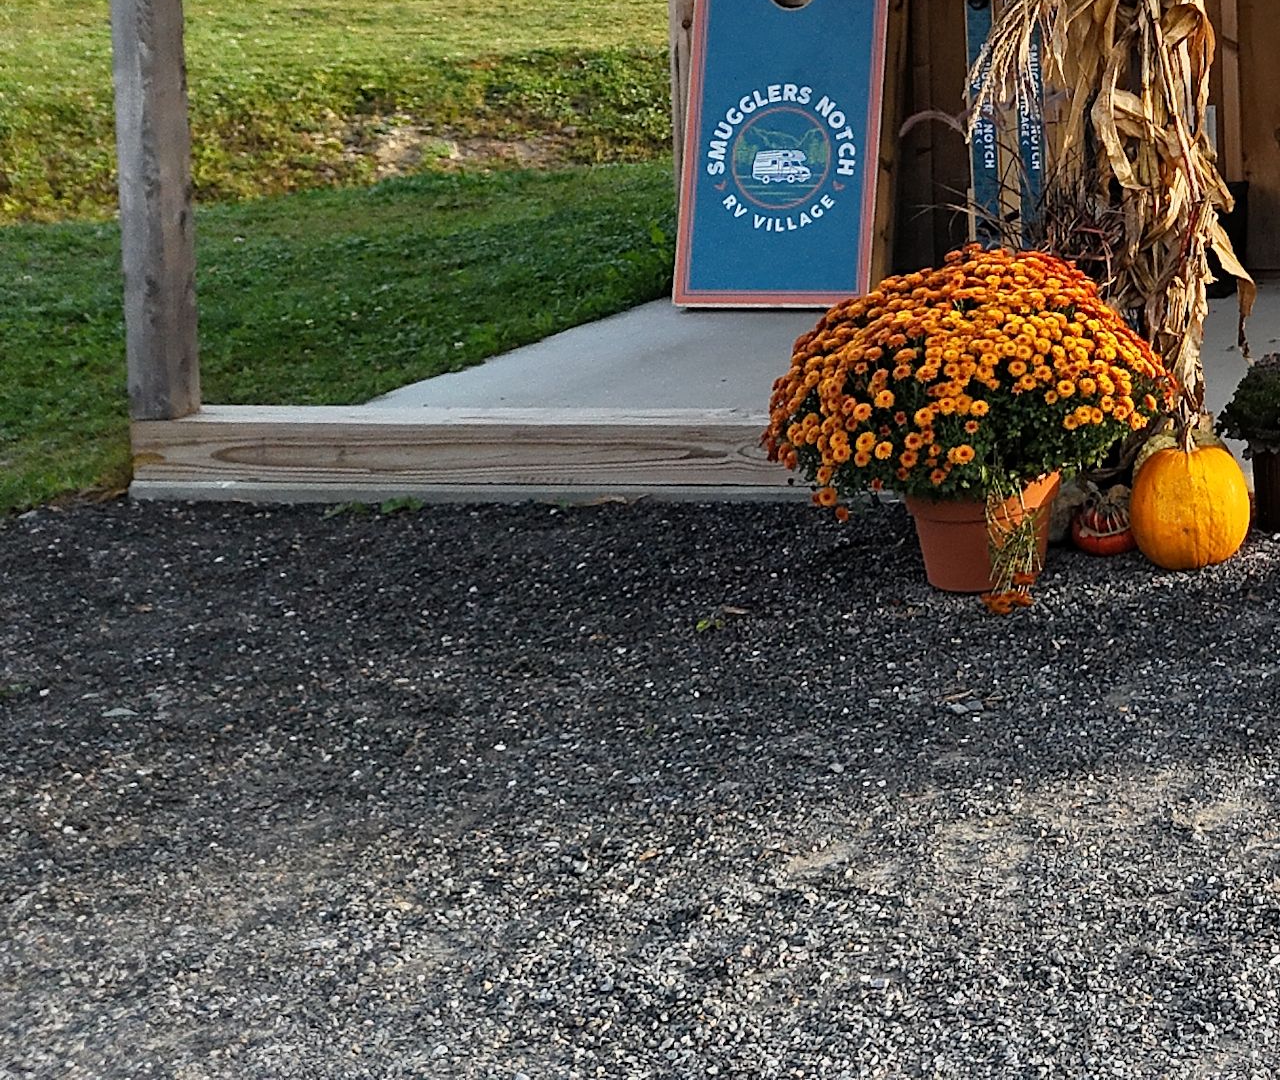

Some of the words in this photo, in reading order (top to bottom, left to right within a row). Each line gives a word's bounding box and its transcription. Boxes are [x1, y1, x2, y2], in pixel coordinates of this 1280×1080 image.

[707, 83, 813, 176] SMUGGLERS
[814, 95, 856, 176] NOTCH
[983, 123, 995, 169] NOTCH
[1030, 124, 1041, 170] NOTCH
[722, 194, 748, 218] RV
[753, 194, 835, 232] VILLAGE
